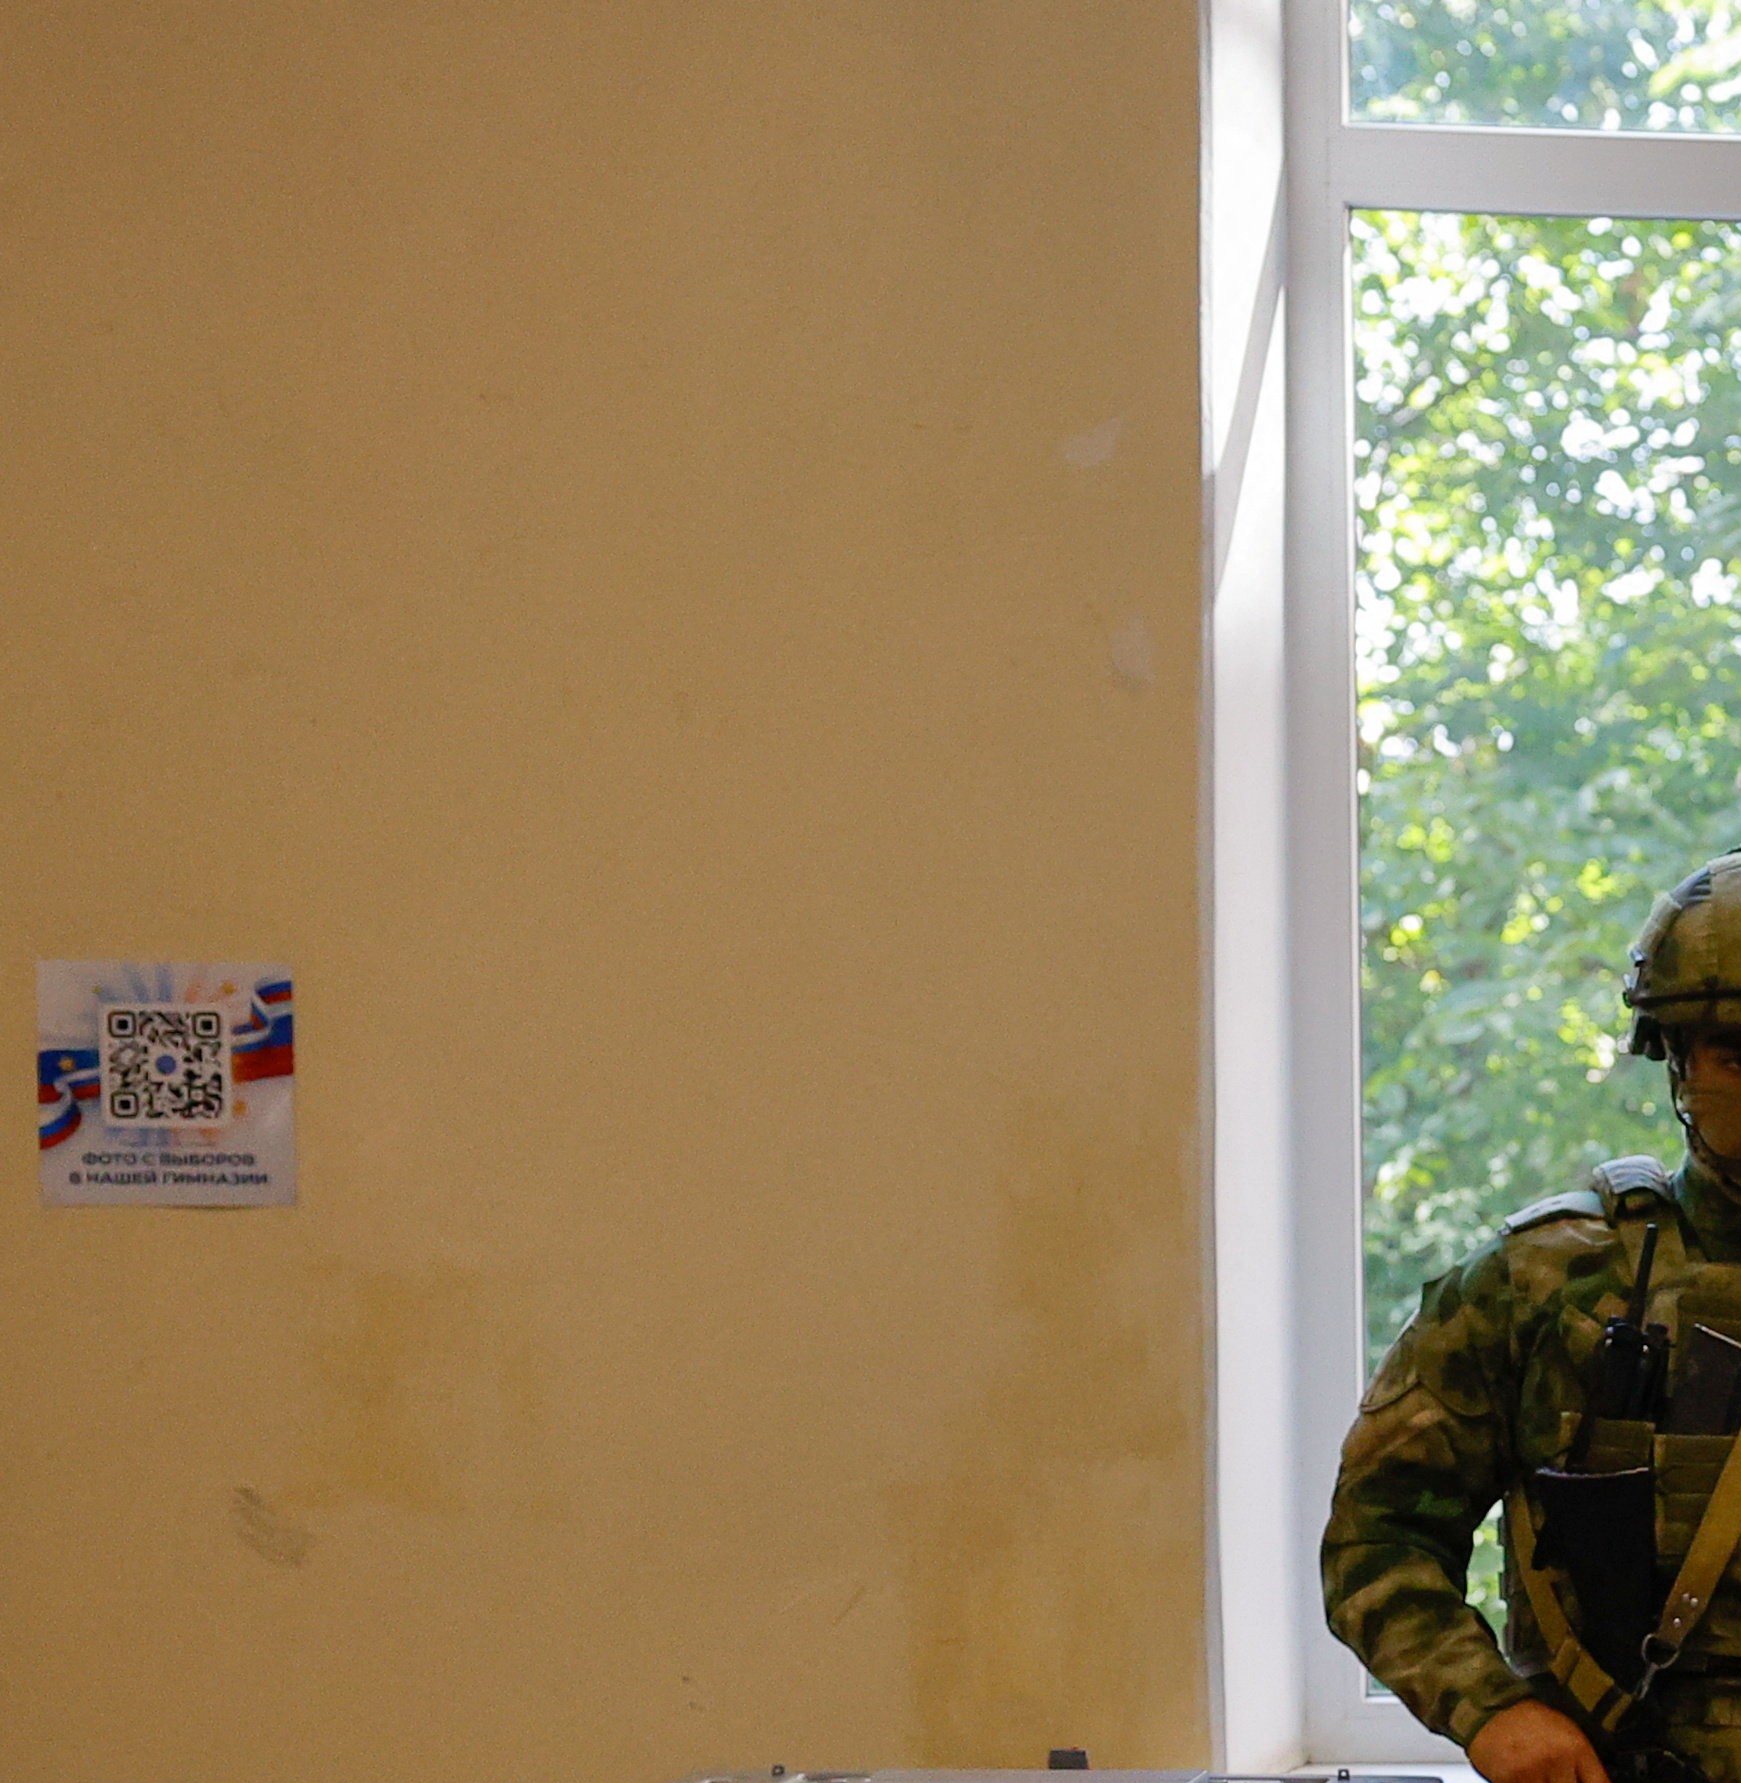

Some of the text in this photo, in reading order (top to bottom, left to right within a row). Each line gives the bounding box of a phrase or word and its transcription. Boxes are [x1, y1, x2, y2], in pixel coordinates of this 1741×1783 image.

[82, 1152, 256, 1167] ФОТО С ВЫБОРОВ
[86, 1169, 158, 1185] НАШЕЙ
[162, 1170, 269, 1186] ГИМНАЗИИ
